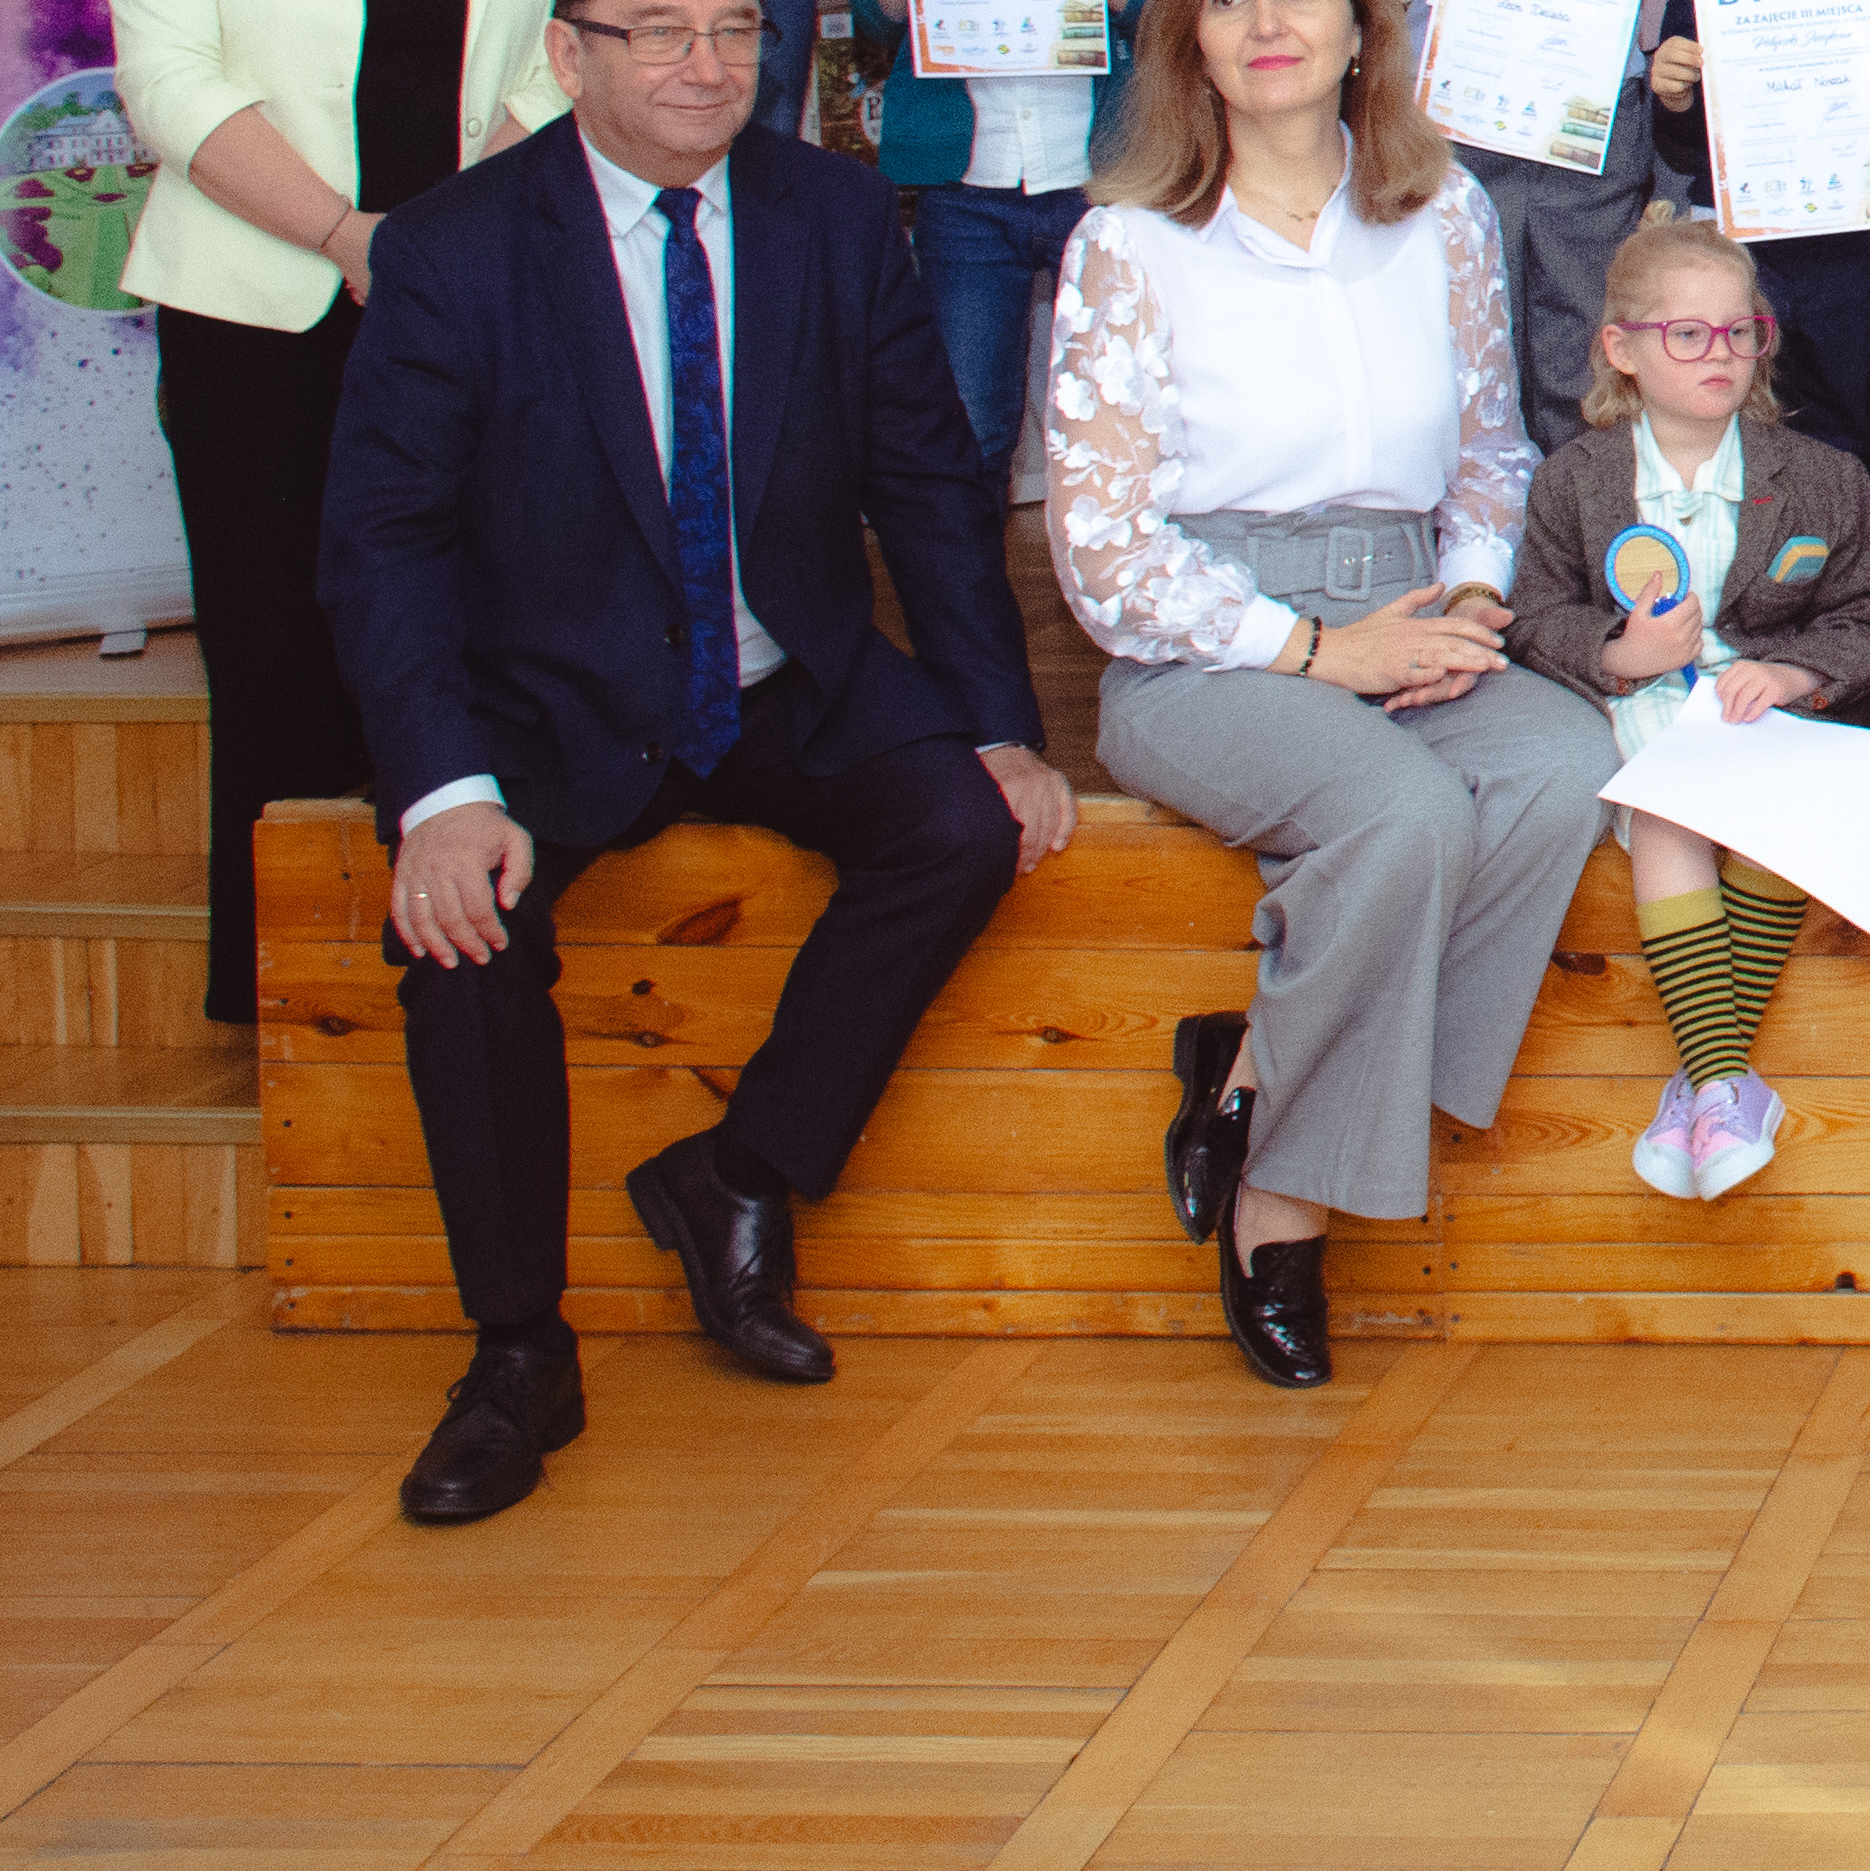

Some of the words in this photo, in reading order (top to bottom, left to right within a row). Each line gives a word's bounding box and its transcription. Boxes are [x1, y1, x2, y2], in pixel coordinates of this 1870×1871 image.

[1736, 14, 1752, 25] ZA
[1754, 11, 1799, 25] ZAJĘCIE
[1817, 4, 1863, 20] MIEJSCA
